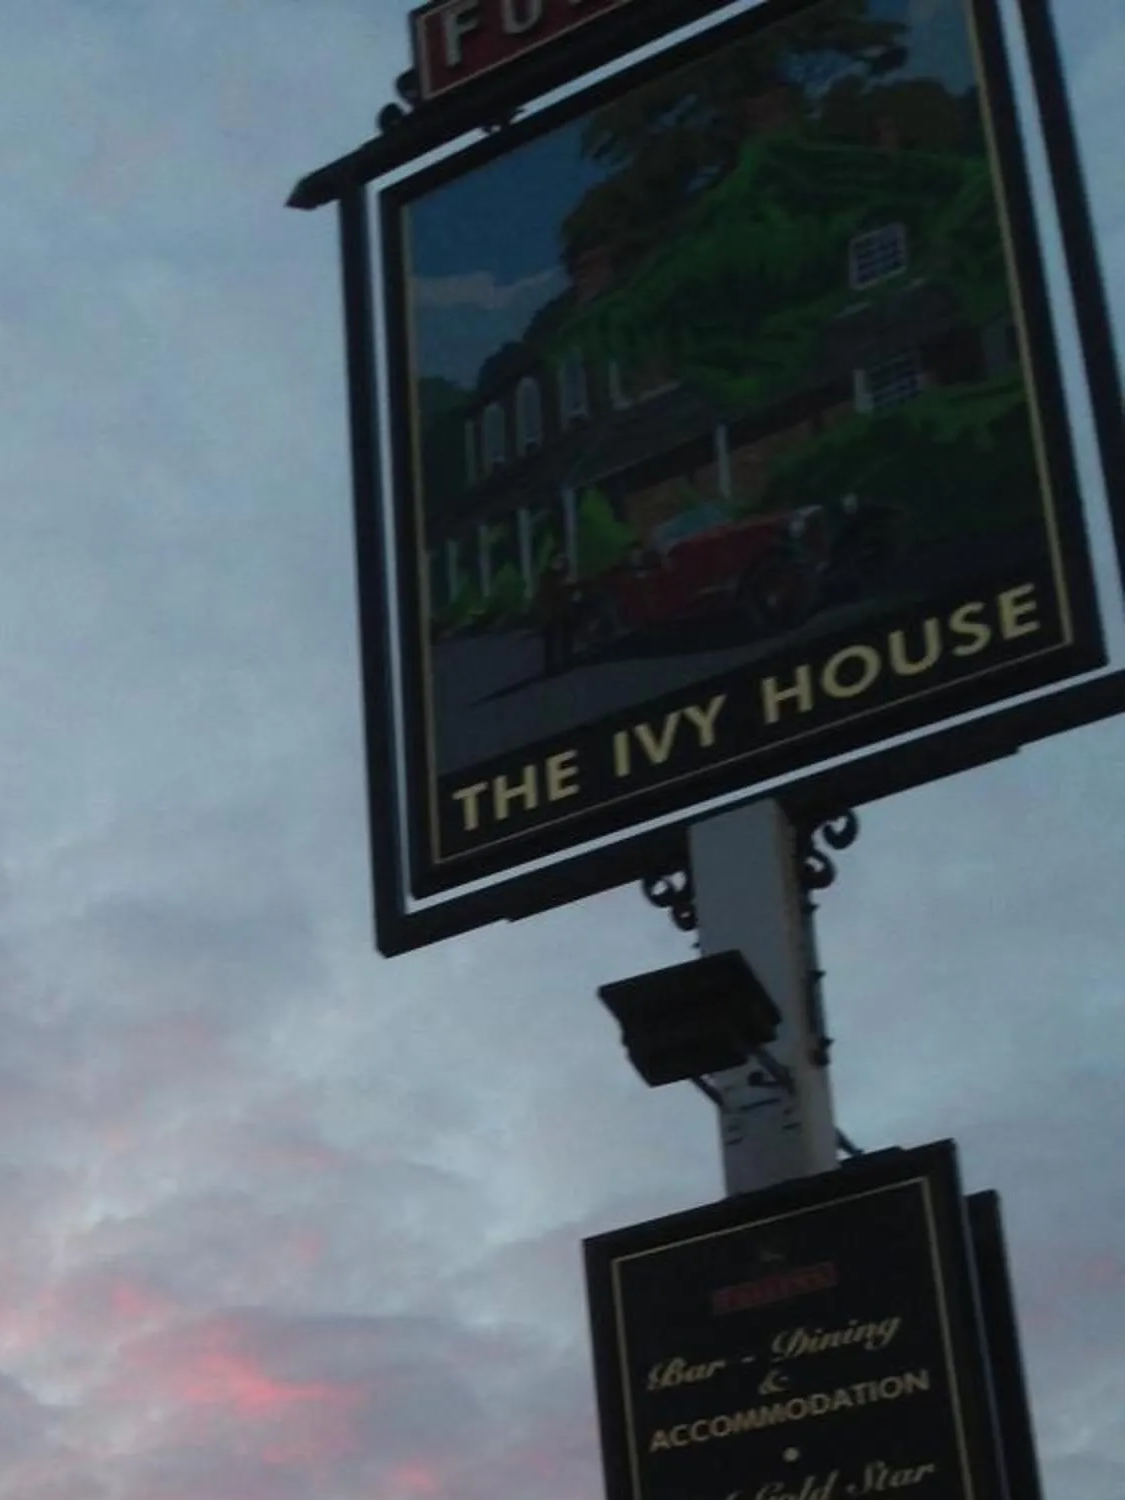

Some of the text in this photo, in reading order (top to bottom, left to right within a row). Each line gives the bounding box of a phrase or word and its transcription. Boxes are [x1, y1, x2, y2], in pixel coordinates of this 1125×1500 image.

[452, 583, 1041, 832] THE IVY HOUSE
[647, 1356, 728, 1391] Bar
[772, 1315, 902, 1362] Dining
[758, 1370, 789, 1395] &
[649, 1368, 930, 1453] ACCOMMODATION
[845, 1460, 936, 1496] Star
